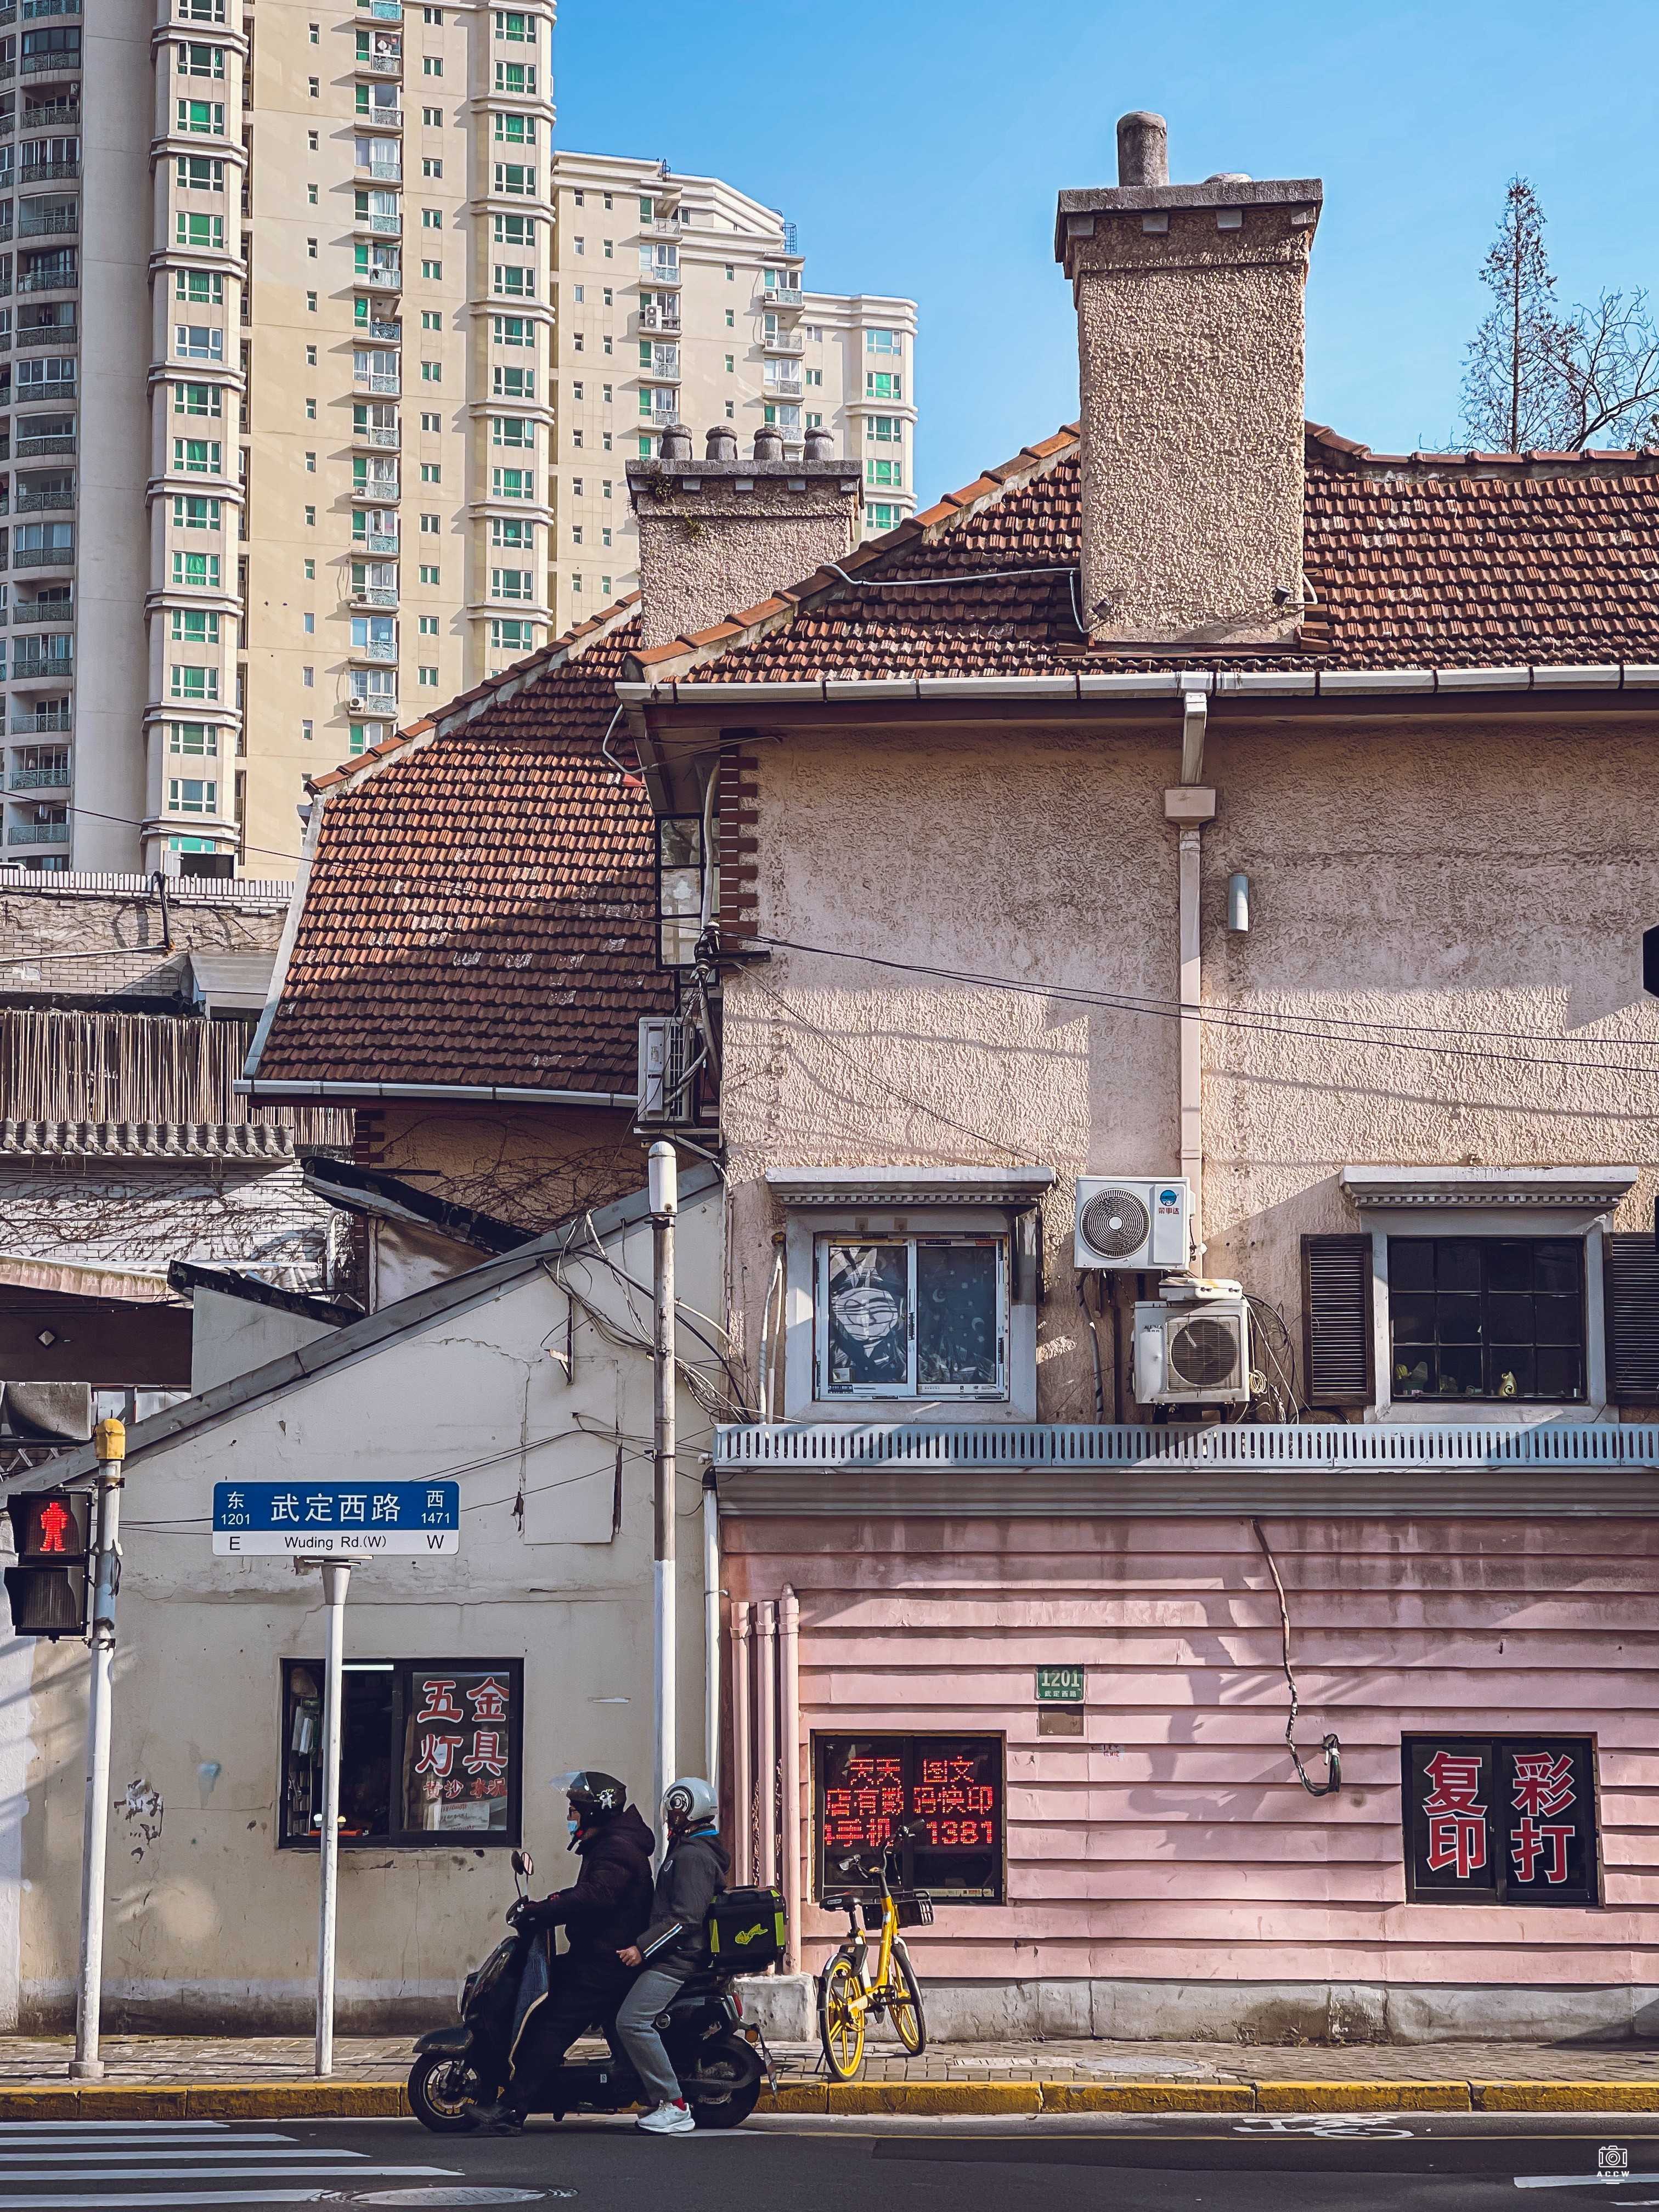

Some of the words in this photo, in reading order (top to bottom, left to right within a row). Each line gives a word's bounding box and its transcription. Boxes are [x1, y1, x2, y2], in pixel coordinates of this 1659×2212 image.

[227, 1491, 245, 1509] 东
[270, 1493, 400, 1522] 武定西路
[426, 1490, 445, 1508] 西
[221, 1513, 250, 1525] 1201
[421, 1513, 450, 1524] 1471
[229, 1536, 241, 1550] E
[285, 1536, 334, 1550] Wuding
[427, 1534, 445, 1549] W
[1041, 1669, 1080, 1687] 1201
[417, 1677, 510, 1723] 五金
[415, 1730, 508, 1777] 灯具
[924, 1756, 974, 1783] 图文
[1422, 1751, 1488, 1878] 复印
[1510, 1752, 1577, 1883] 彩打
[926, 1820, 993, 1846] 1381
